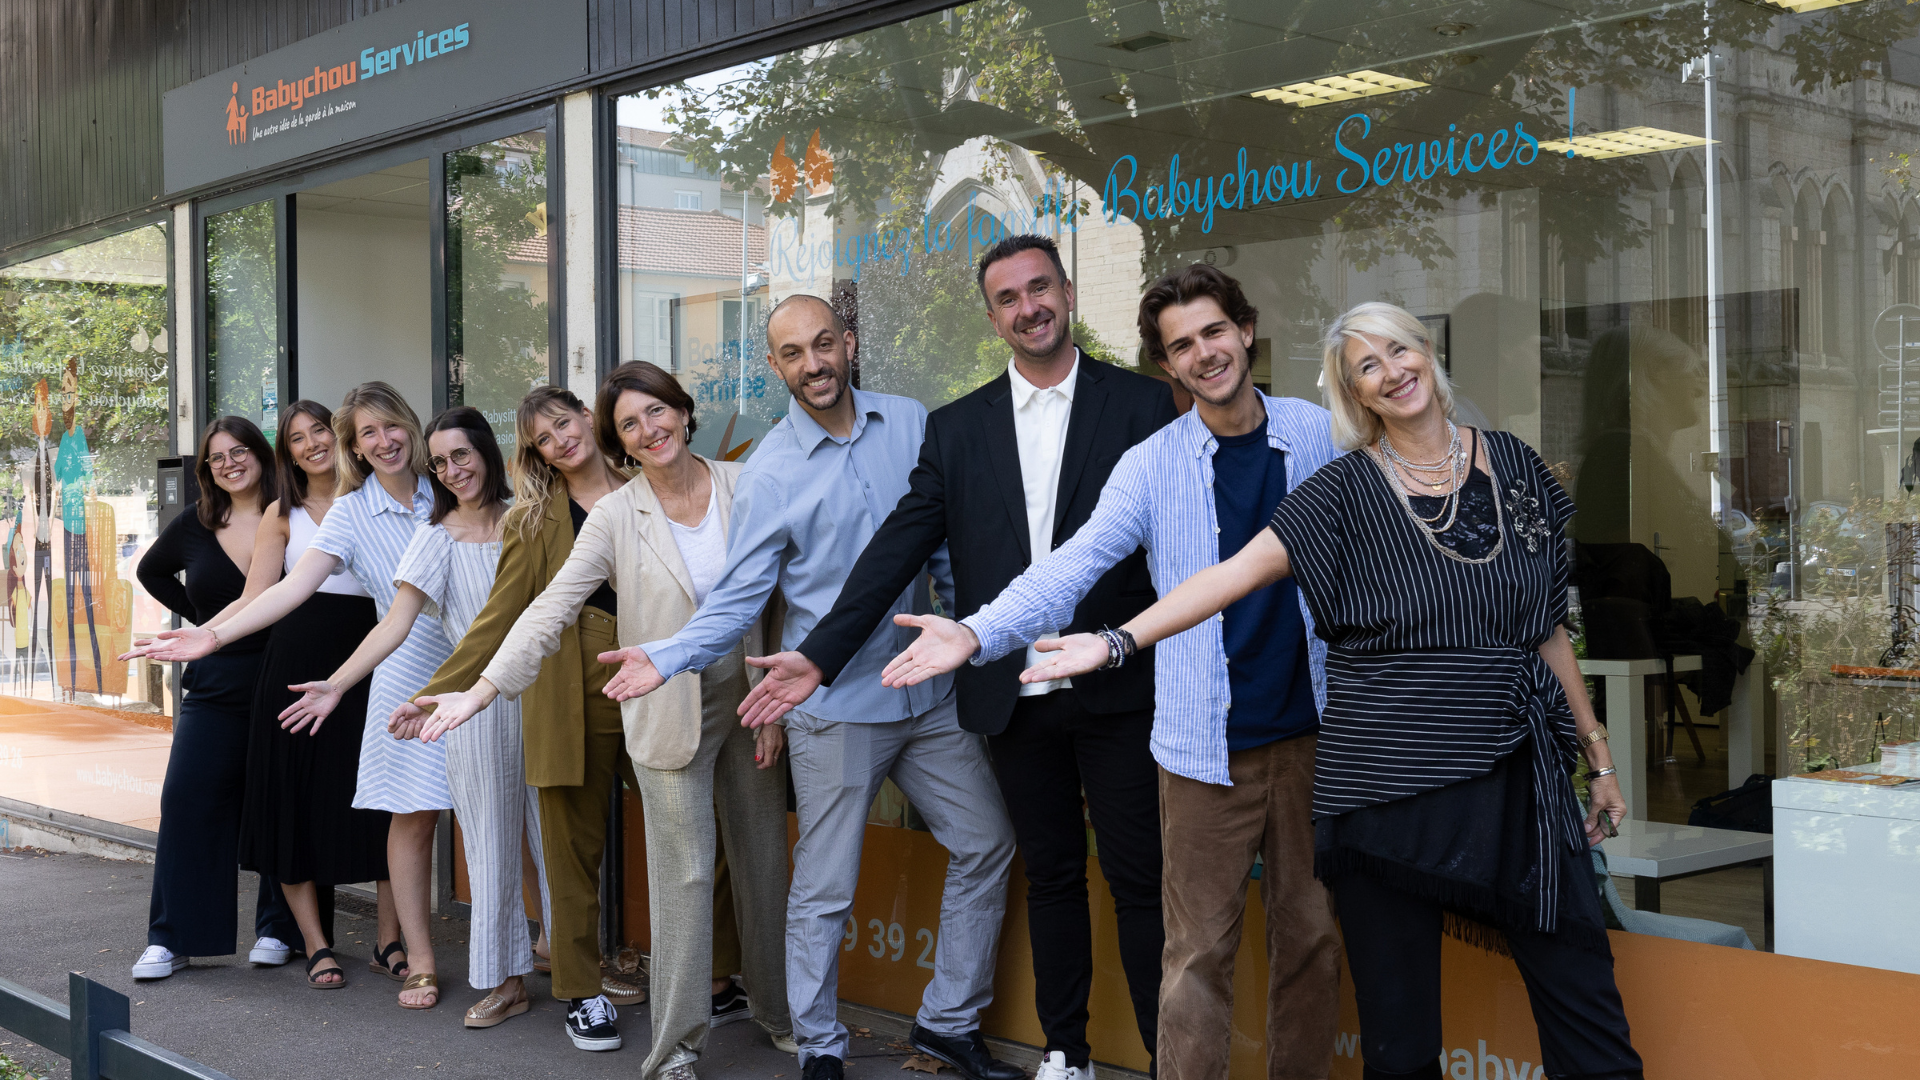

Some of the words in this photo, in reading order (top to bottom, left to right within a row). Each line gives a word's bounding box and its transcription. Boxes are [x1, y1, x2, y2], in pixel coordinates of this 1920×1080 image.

[252, 61, 357, 116] Babychou
[360, 22, 470, 80] Services
[252, 127, 263, 141] Une
[264, 124, 279, 136] autre
[280, 118, 290, 132] idée
[291, 115, 298, 128] de
[298, 113, 304, 125] la
[305, 107, 321, 127] garde
[322, 106, 327, 118] à
[328, 103, 334, 117] la
[335, 100, 357, 114] maison
[769, 215, 914, 289] Rejoignez
[924, 198, 958, 254] la
[968, 175, 1087, 267] famille
[1102, 146, 1321, 234] Babychou
[1334, 113, 1539, 194] Services
[1566, 87, 1576, 159] !
[687, 337, 754, 367] Bonne
[689, 365, 766, 403] rentrée
[76, 763, 161, 797] www.babychou.com
[868, 918, 905, 962] 39
[915, 927, 935, 970] 2
